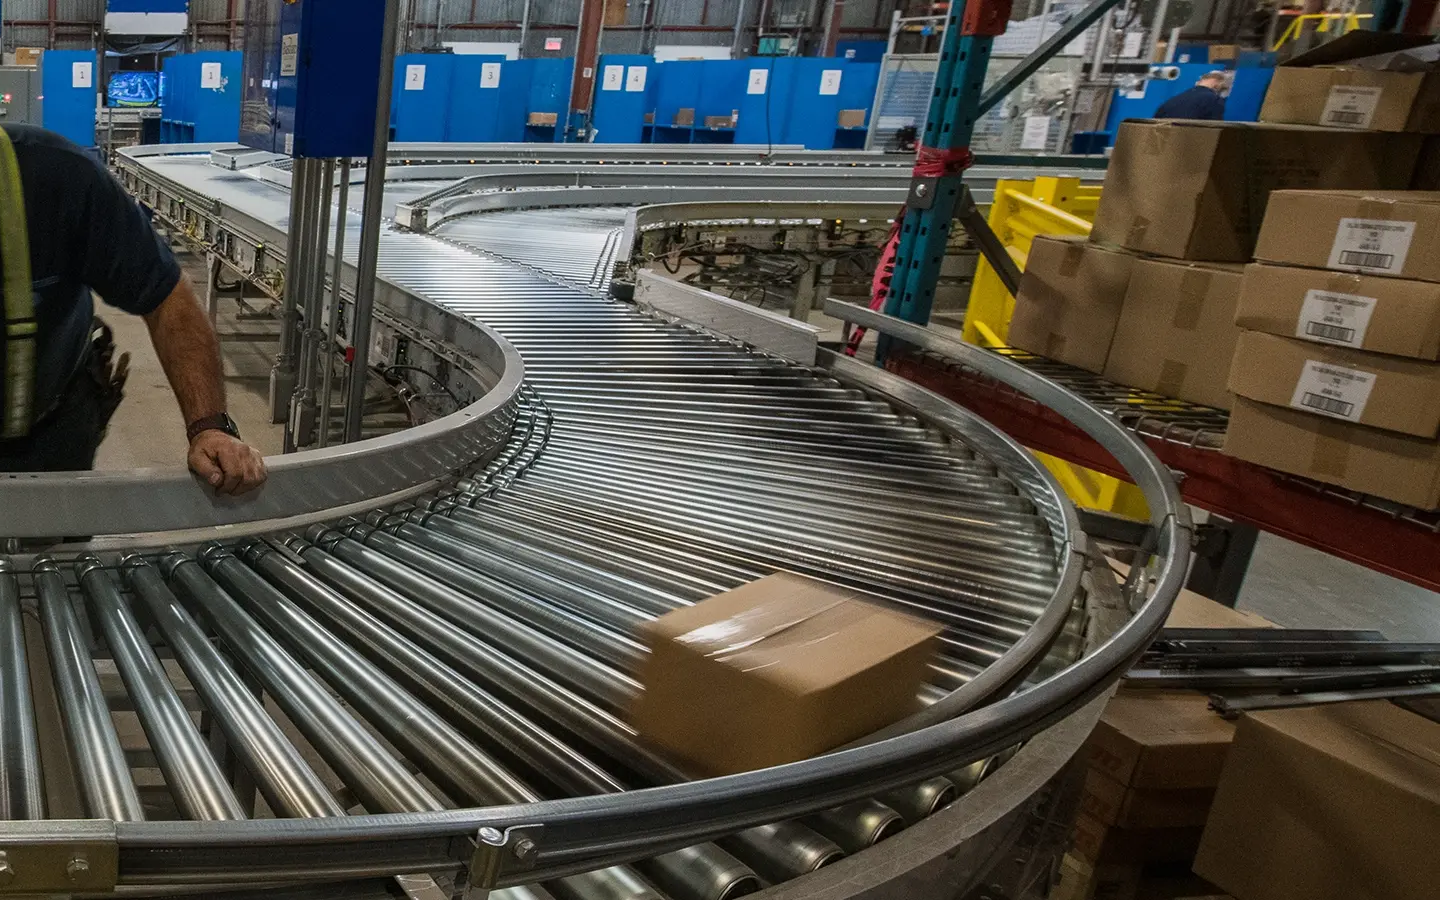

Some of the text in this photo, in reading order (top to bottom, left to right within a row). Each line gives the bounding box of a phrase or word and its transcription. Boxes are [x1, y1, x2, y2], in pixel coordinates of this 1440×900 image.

[412, 73, 418, 82] 2
[487, 71, 493, 80] 3
[611, 74, 617, 82] 3
